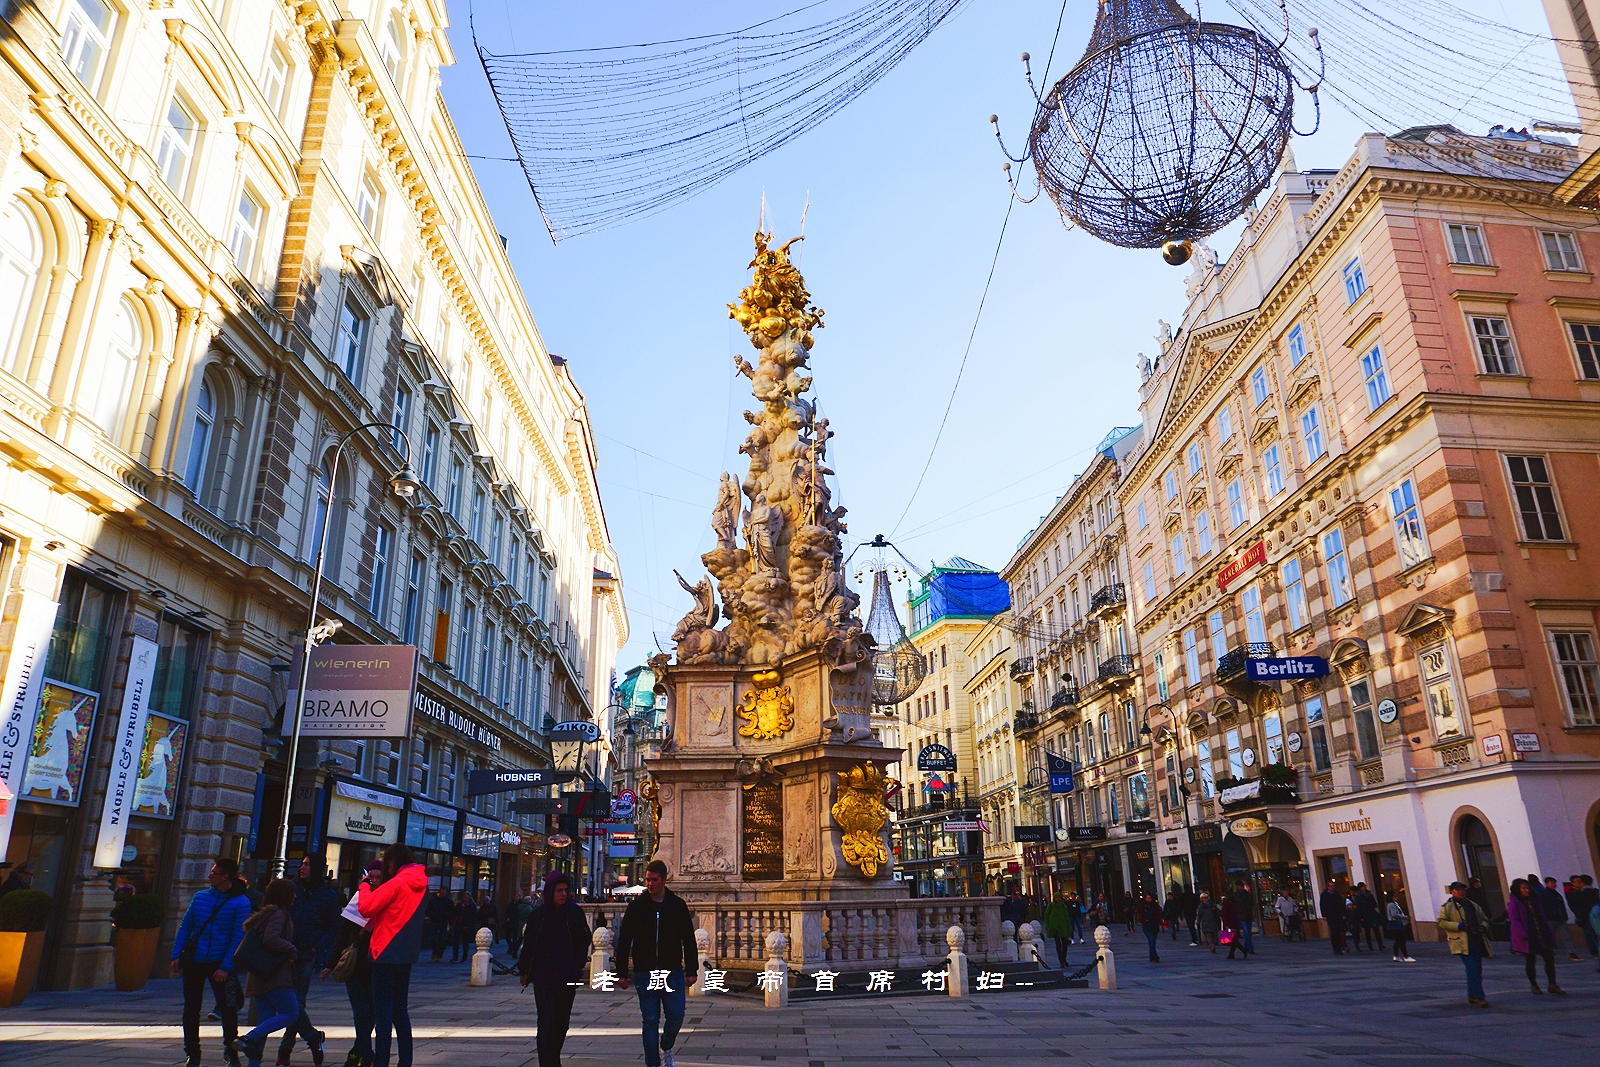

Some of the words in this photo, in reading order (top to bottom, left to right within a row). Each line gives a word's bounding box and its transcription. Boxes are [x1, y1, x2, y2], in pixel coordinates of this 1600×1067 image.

[1220, 557, 1248, 583] GENERALI
[1247, 546, 1261, 563] HOF
[314, 659, 390, 669] wienerin
[1256, 660, 1315, 676] Berlitz
[11, 642, 37, 723] STRUBELL
[838, 673, 867, 687] DEO
[125, 678, 144, 748] STRUBELL
[303, 700, 389, 718] BRAMO
[448, 709, 477, 737] RUDOLF
[477, 726, 502, 752] HÜBNER
[119, 746, 132, 770] &
[495, 773, 541, 782] HÜBNER
[1052, 777, 1071, 786] LPE
[111, 771, 127, 826] NÄGELE
[520, 801, 556, 811] swatch
[1329, 817, 1372, 835] HELDWEIN
